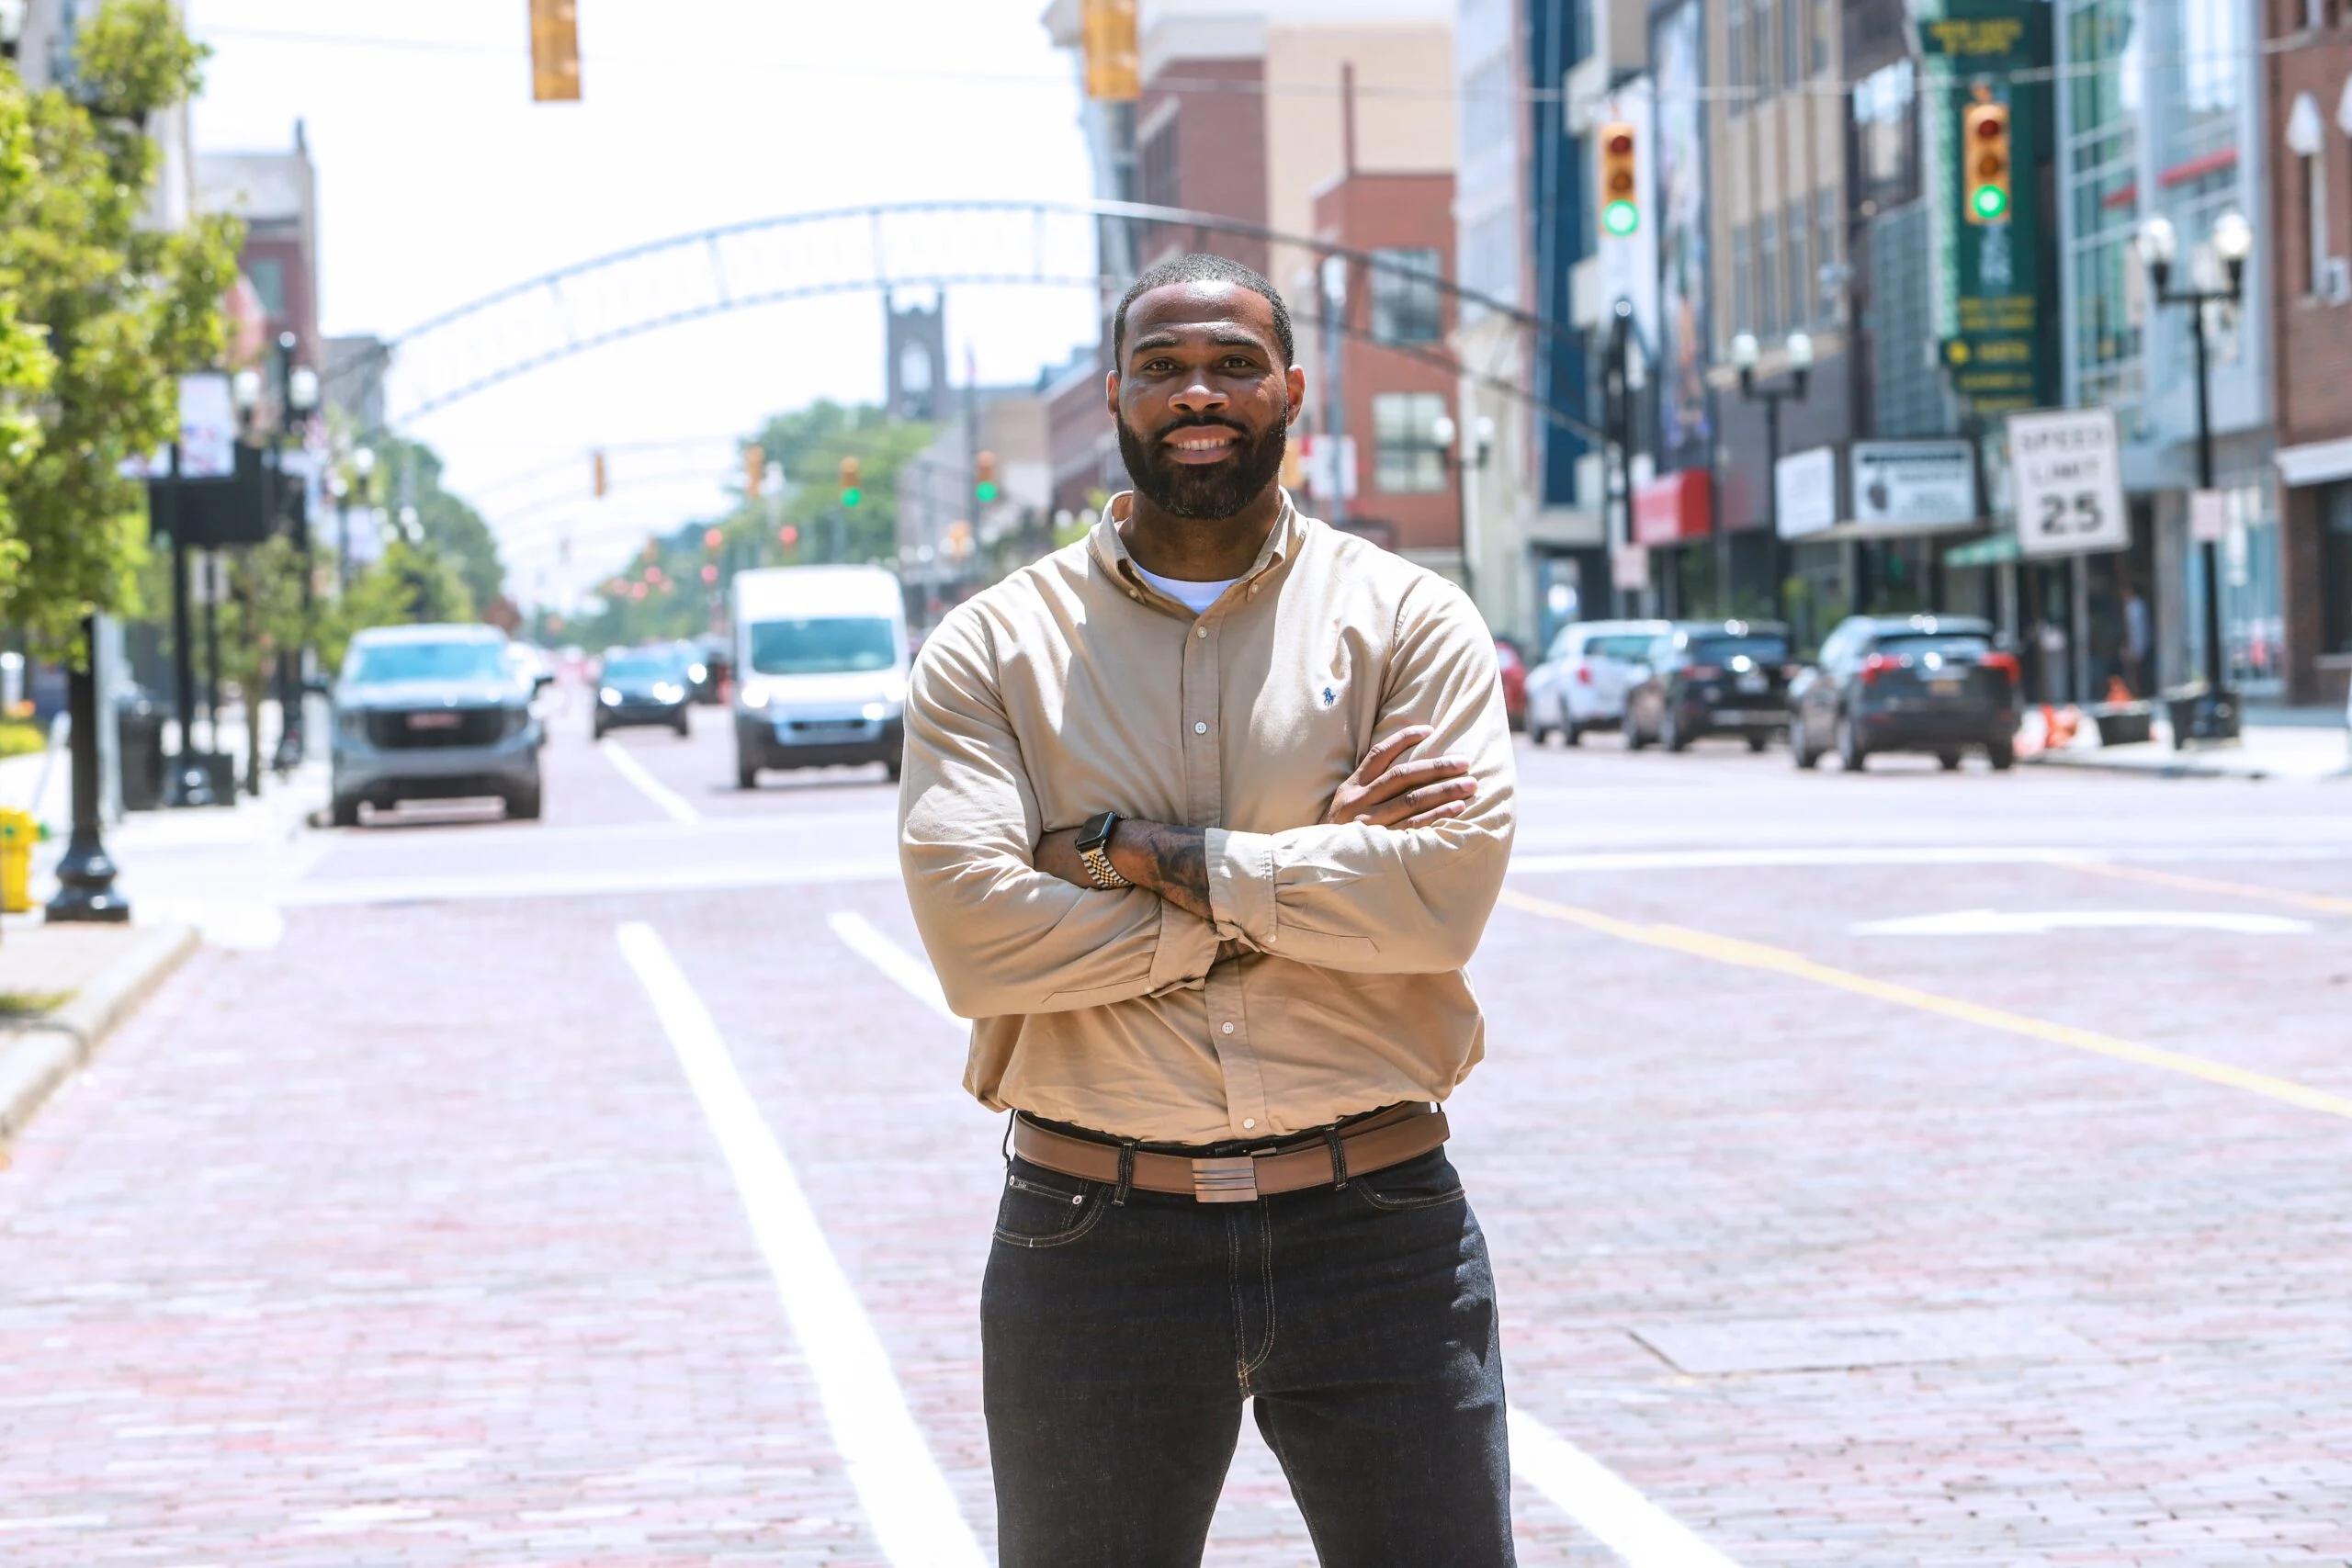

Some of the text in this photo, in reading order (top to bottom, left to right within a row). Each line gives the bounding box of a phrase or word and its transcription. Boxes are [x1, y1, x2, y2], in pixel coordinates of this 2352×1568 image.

[2021, 427, 2105, 453] SPEED
[2029, 456, 2099, 484] LIMIT
[2040, 491, 2105, 535] 25
